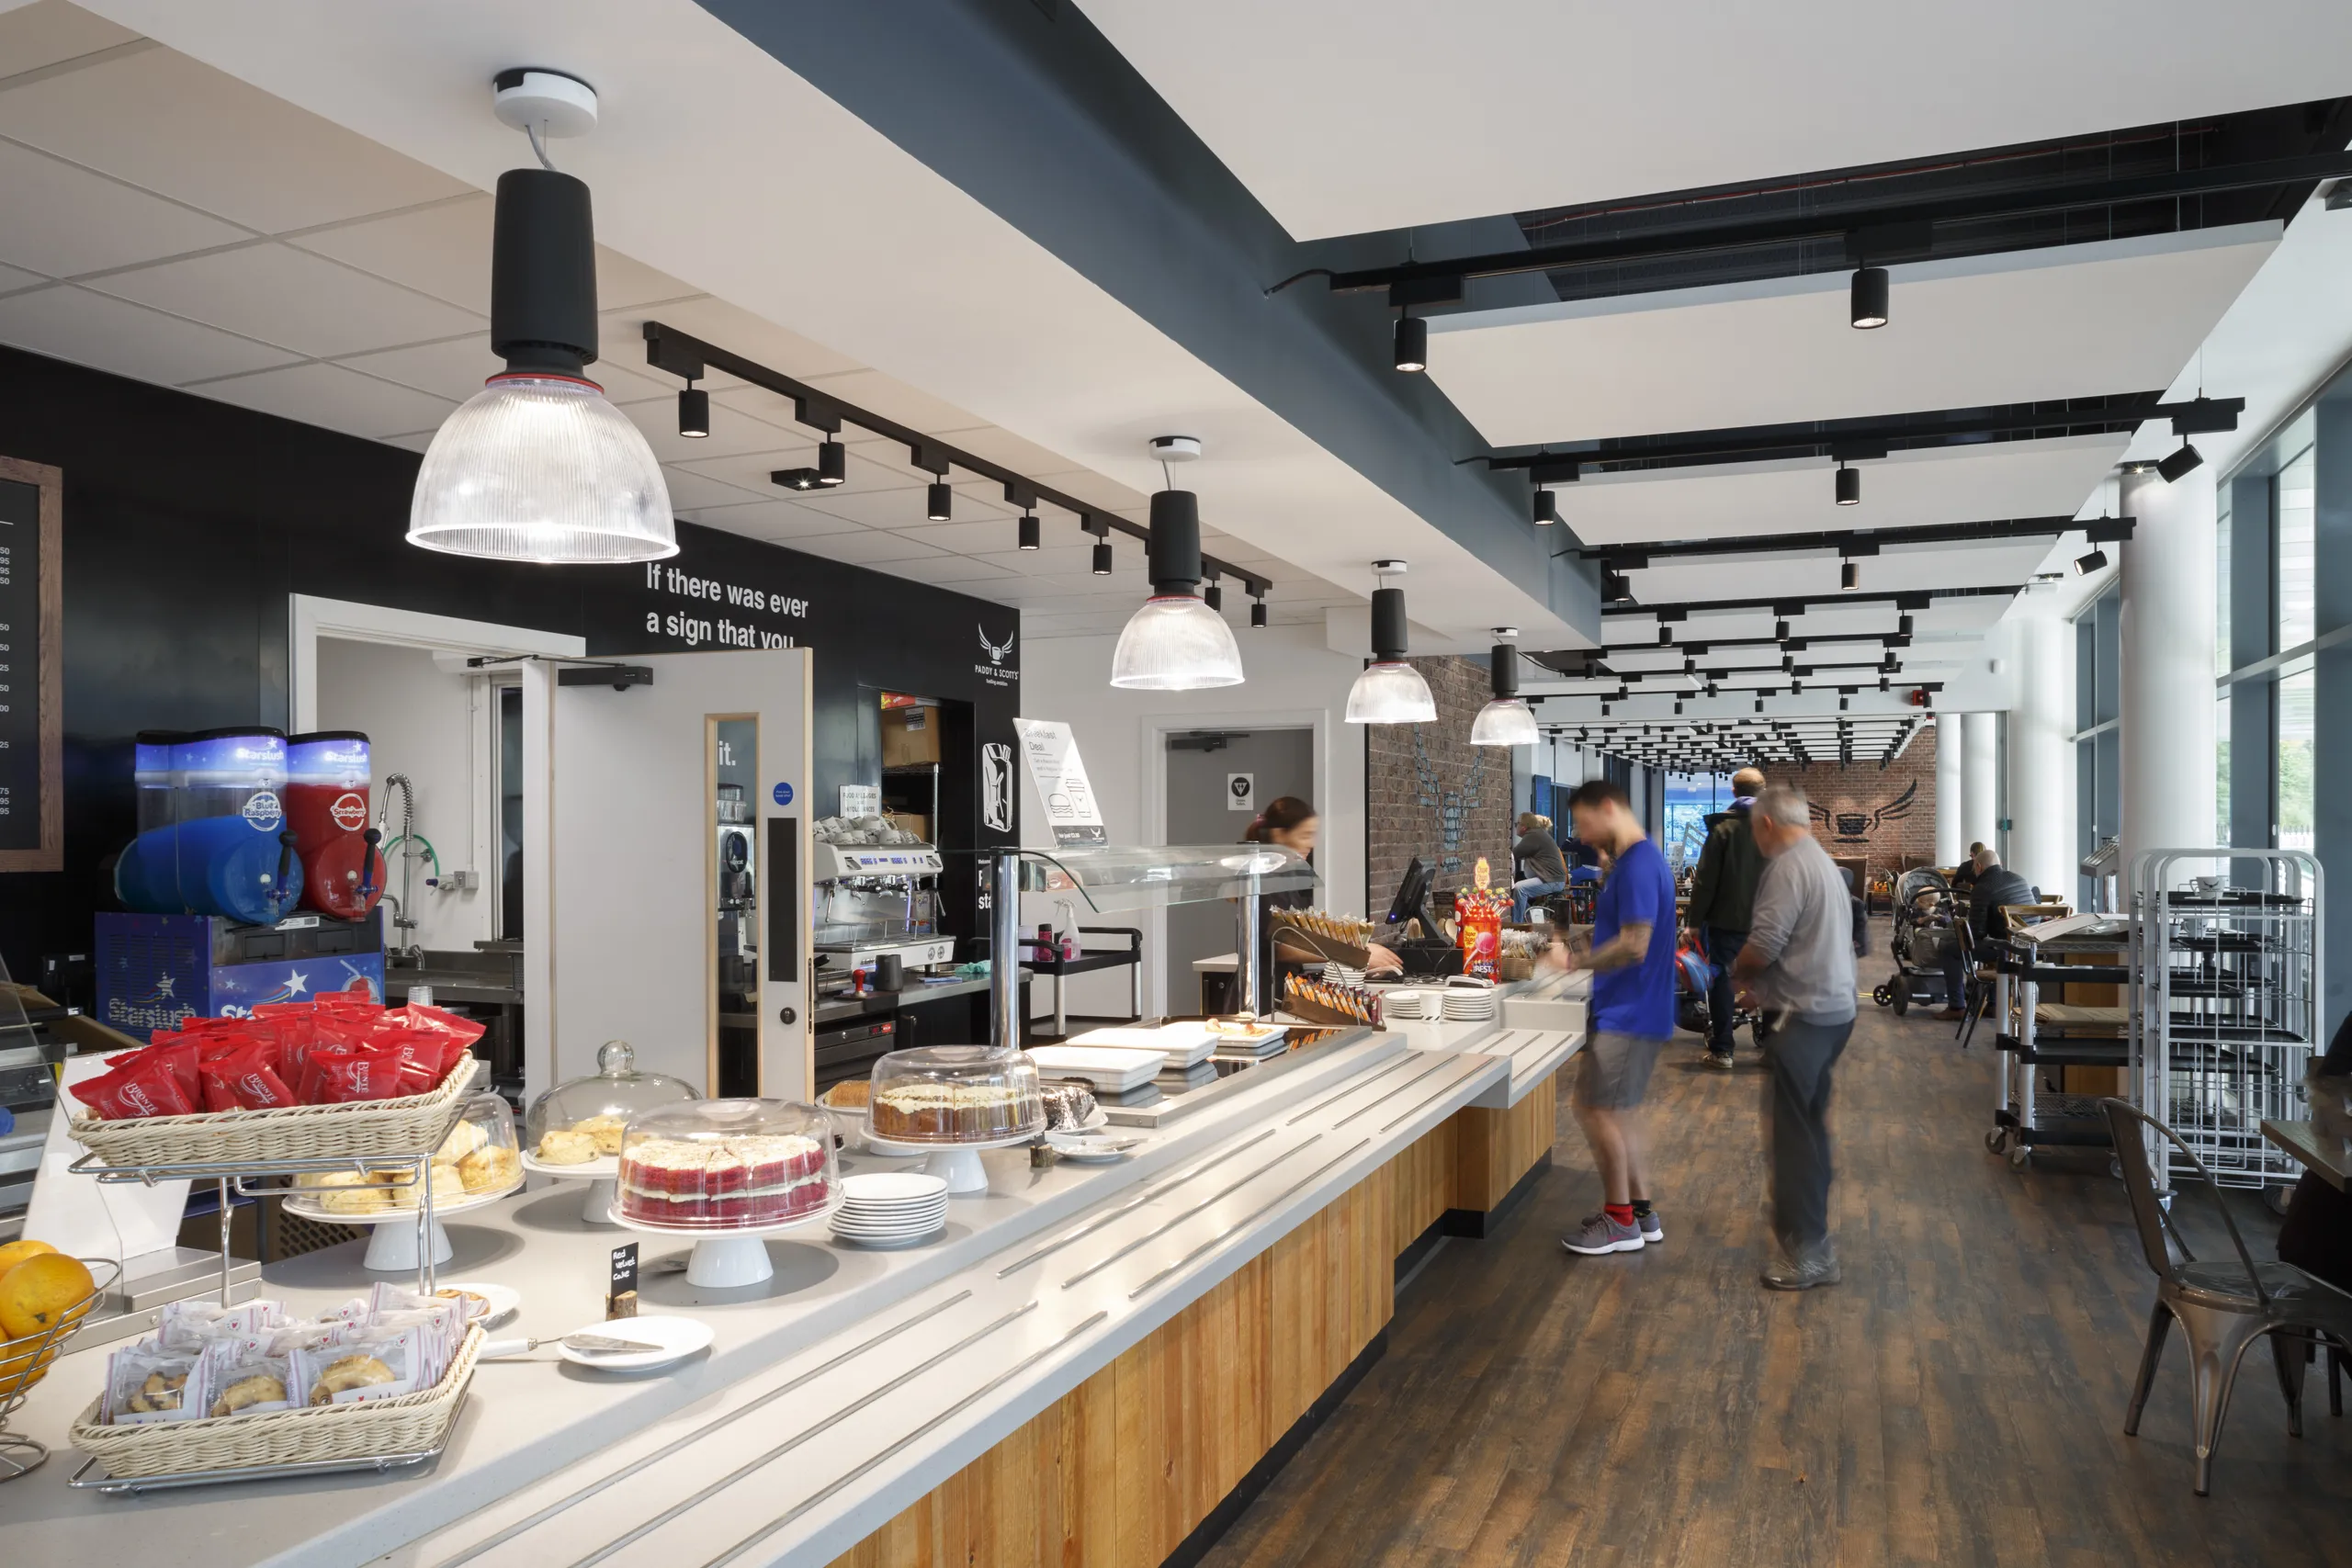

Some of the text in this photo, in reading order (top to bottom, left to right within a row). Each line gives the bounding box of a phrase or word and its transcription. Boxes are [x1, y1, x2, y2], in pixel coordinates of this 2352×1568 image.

[647, 562, 808, 618] If there was ever
[646, 611, 661, 634] a
[666, 611, 712, 646] sign
[718, 619, 755, 649] that
[975, 664, 993, 676] PADDY
[993, 668, 998, 677] &
[718, 740, 736, 766] it.
[244, 807, 281, 819] Raspberry
[334, 807, 366, 818] Strawberry
[613, 1249, 627, 1260] Red
[613, 1269, 630, 1280] Cake
